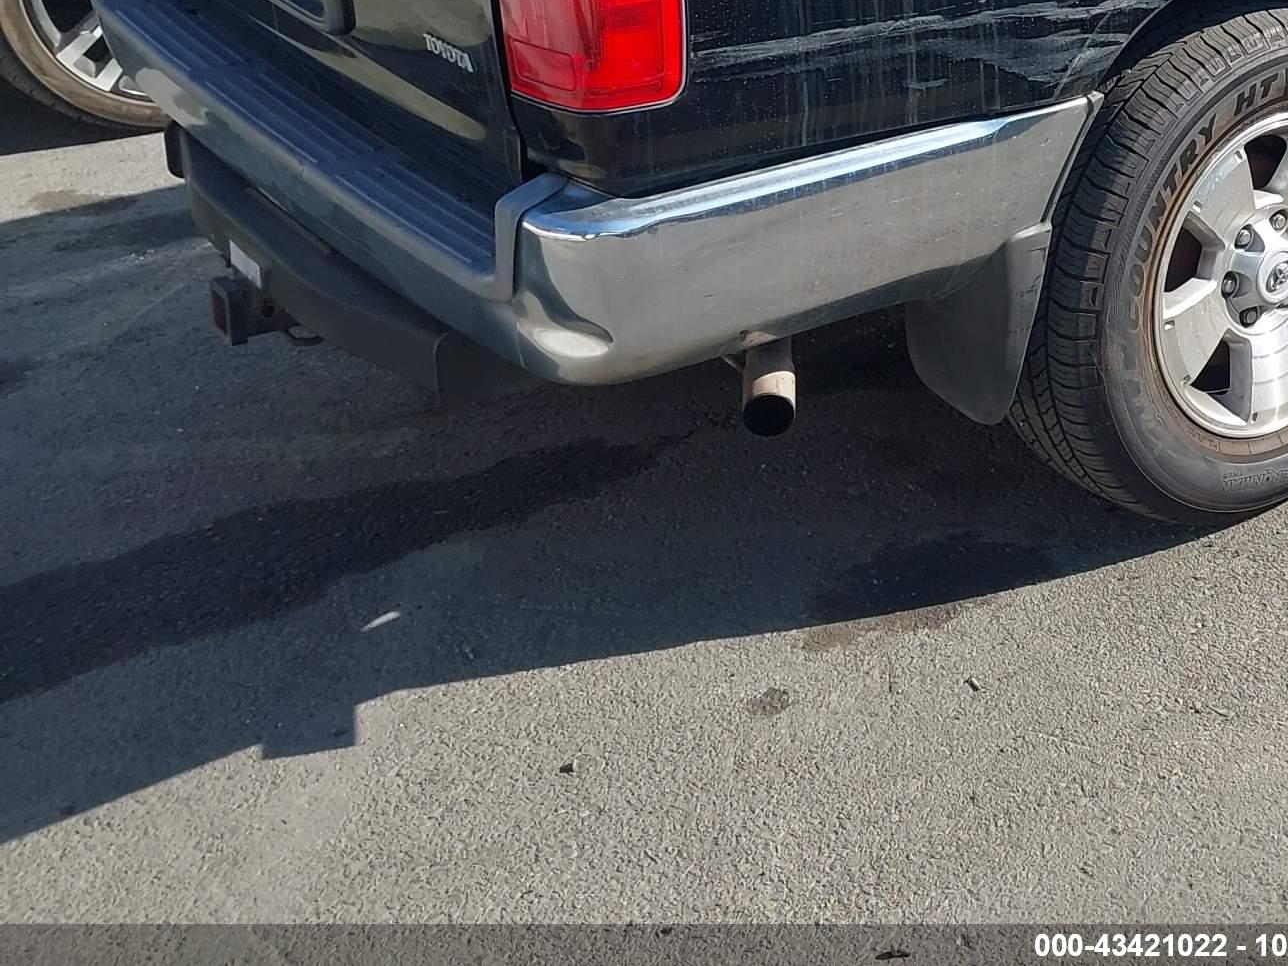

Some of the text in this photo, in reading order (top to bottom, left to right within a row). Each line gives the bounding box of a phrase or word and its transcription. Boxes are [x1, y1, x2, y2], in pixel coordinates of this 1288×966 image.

[422, 33, 474, 73] TOYOTA
[1129, 111, 1219, 332] COUNTRY
[1233, 72, 1280, 117] HT
